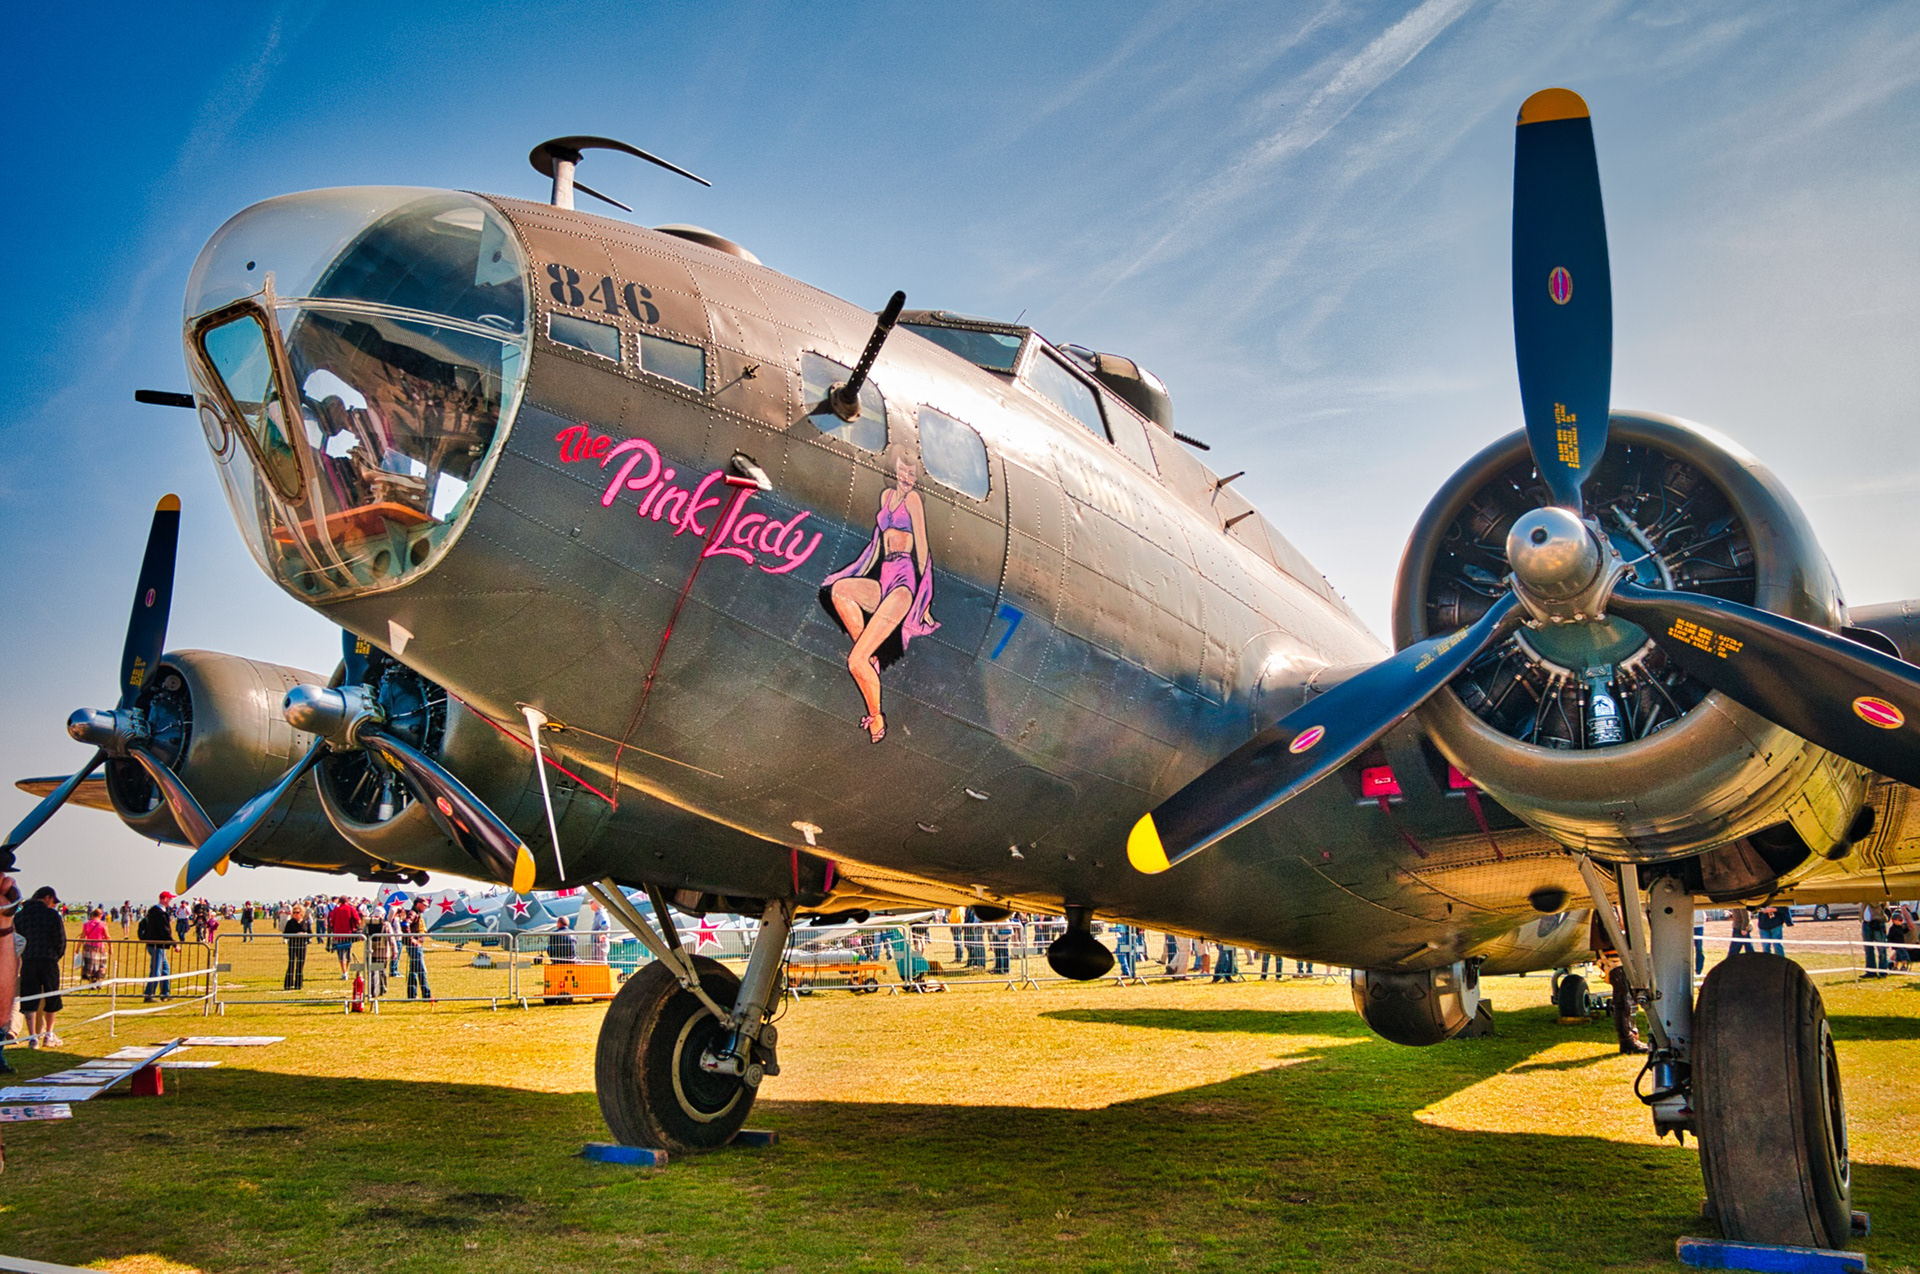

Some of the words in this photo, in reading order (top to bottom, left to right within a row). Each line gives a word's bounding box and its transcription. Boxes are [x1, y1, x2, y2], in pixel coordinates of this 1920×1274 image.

[547, 264, 660, 325] 846
[555, 422, 612, 463] The
[600, 438, 723, 537] Pink
[702, 487, 824, 575] Lady
[990, 603, 1024, 660] 7
